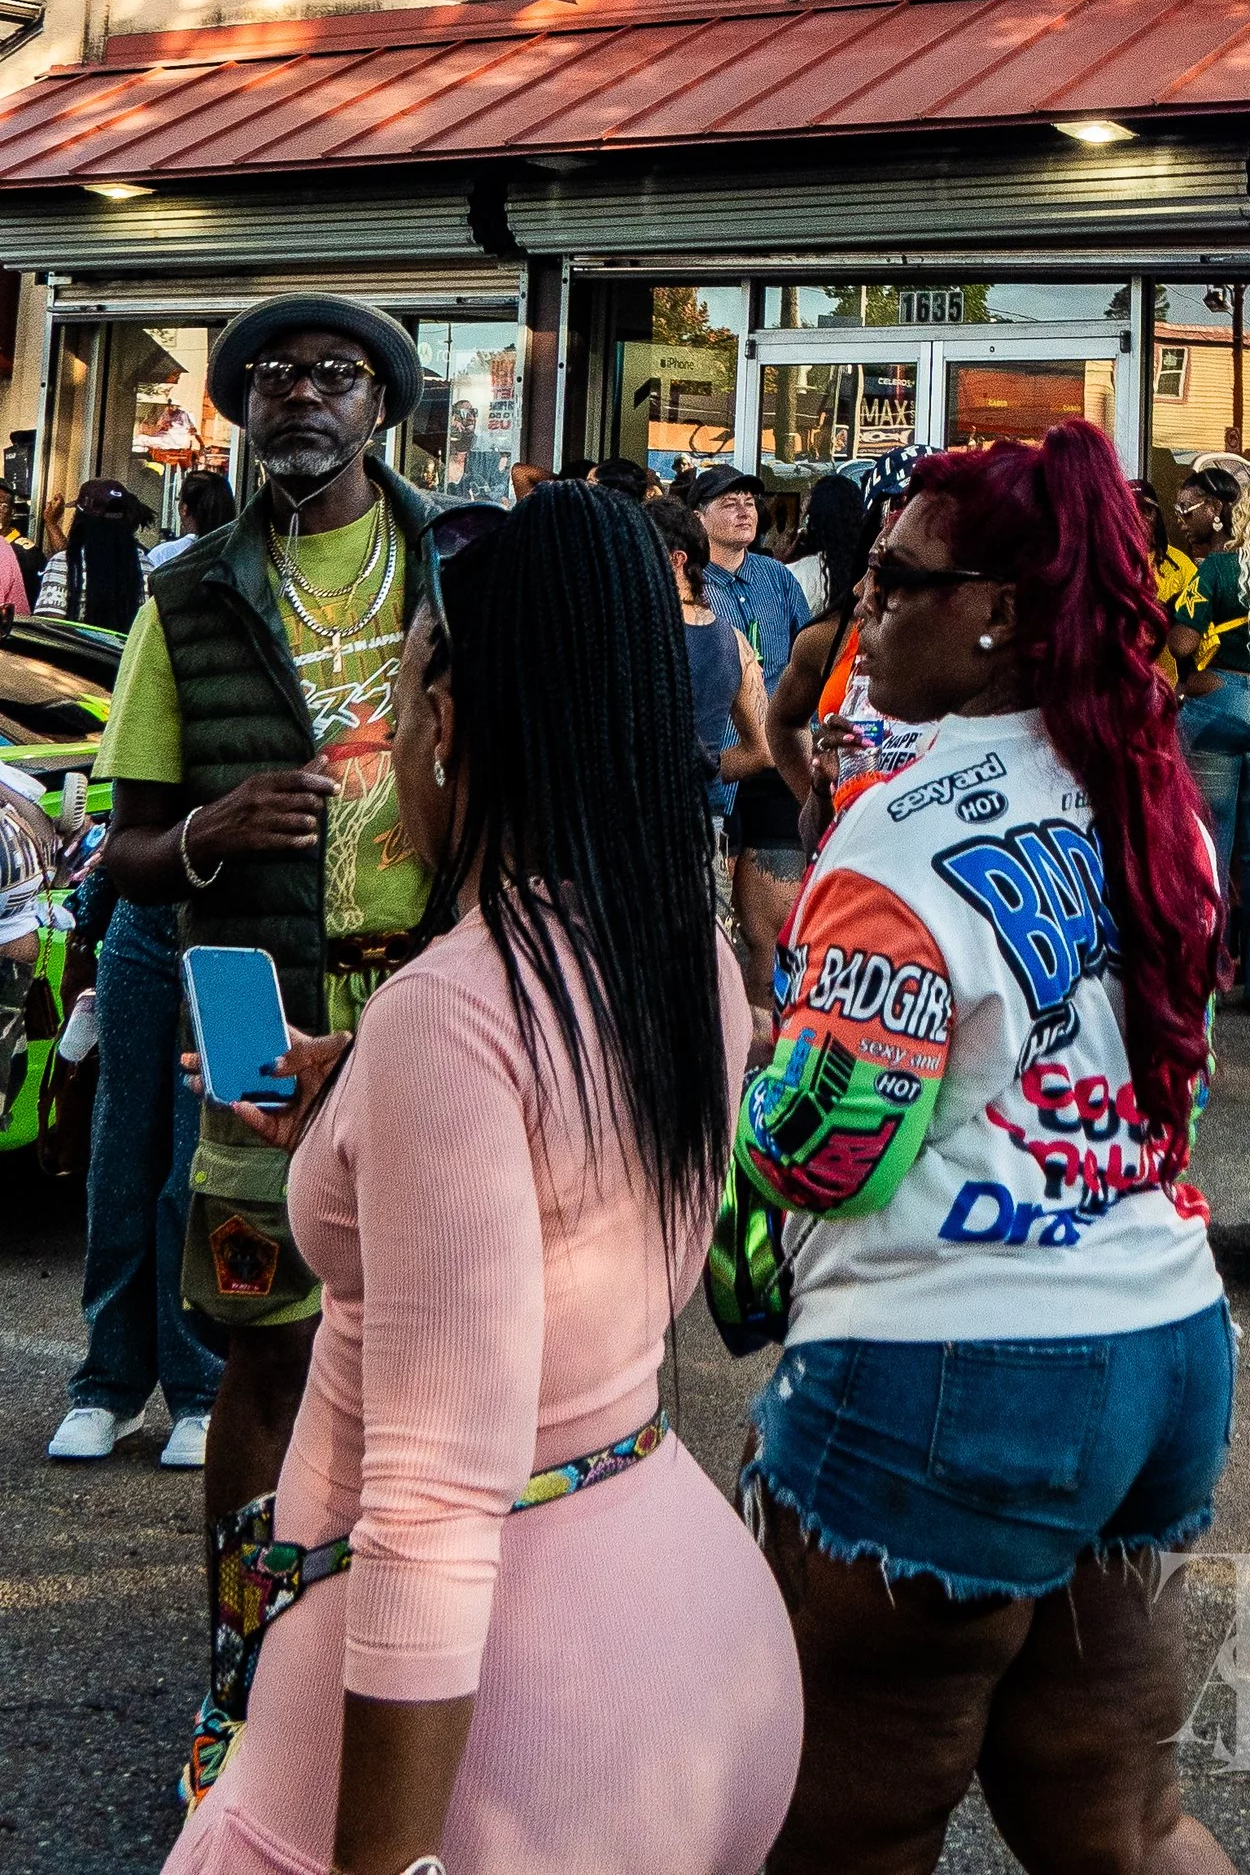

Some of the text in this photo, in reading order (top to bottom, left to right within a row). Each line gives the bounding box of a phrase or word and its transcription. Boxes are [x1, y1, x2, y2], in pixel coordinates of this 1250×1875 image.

[901, 291, 964, 323] 1635
[667, 356, 694, 371] iPhone
[860, 397, 908, 426] MAX
[882, 732, 922, 749] HAPP
[952, 752, 1006, 790] and
[960, 792, 1002, 821] HOT
[858, 1036, 908, 1069] sexy
[878, 1073, 919, 1099] HOT
